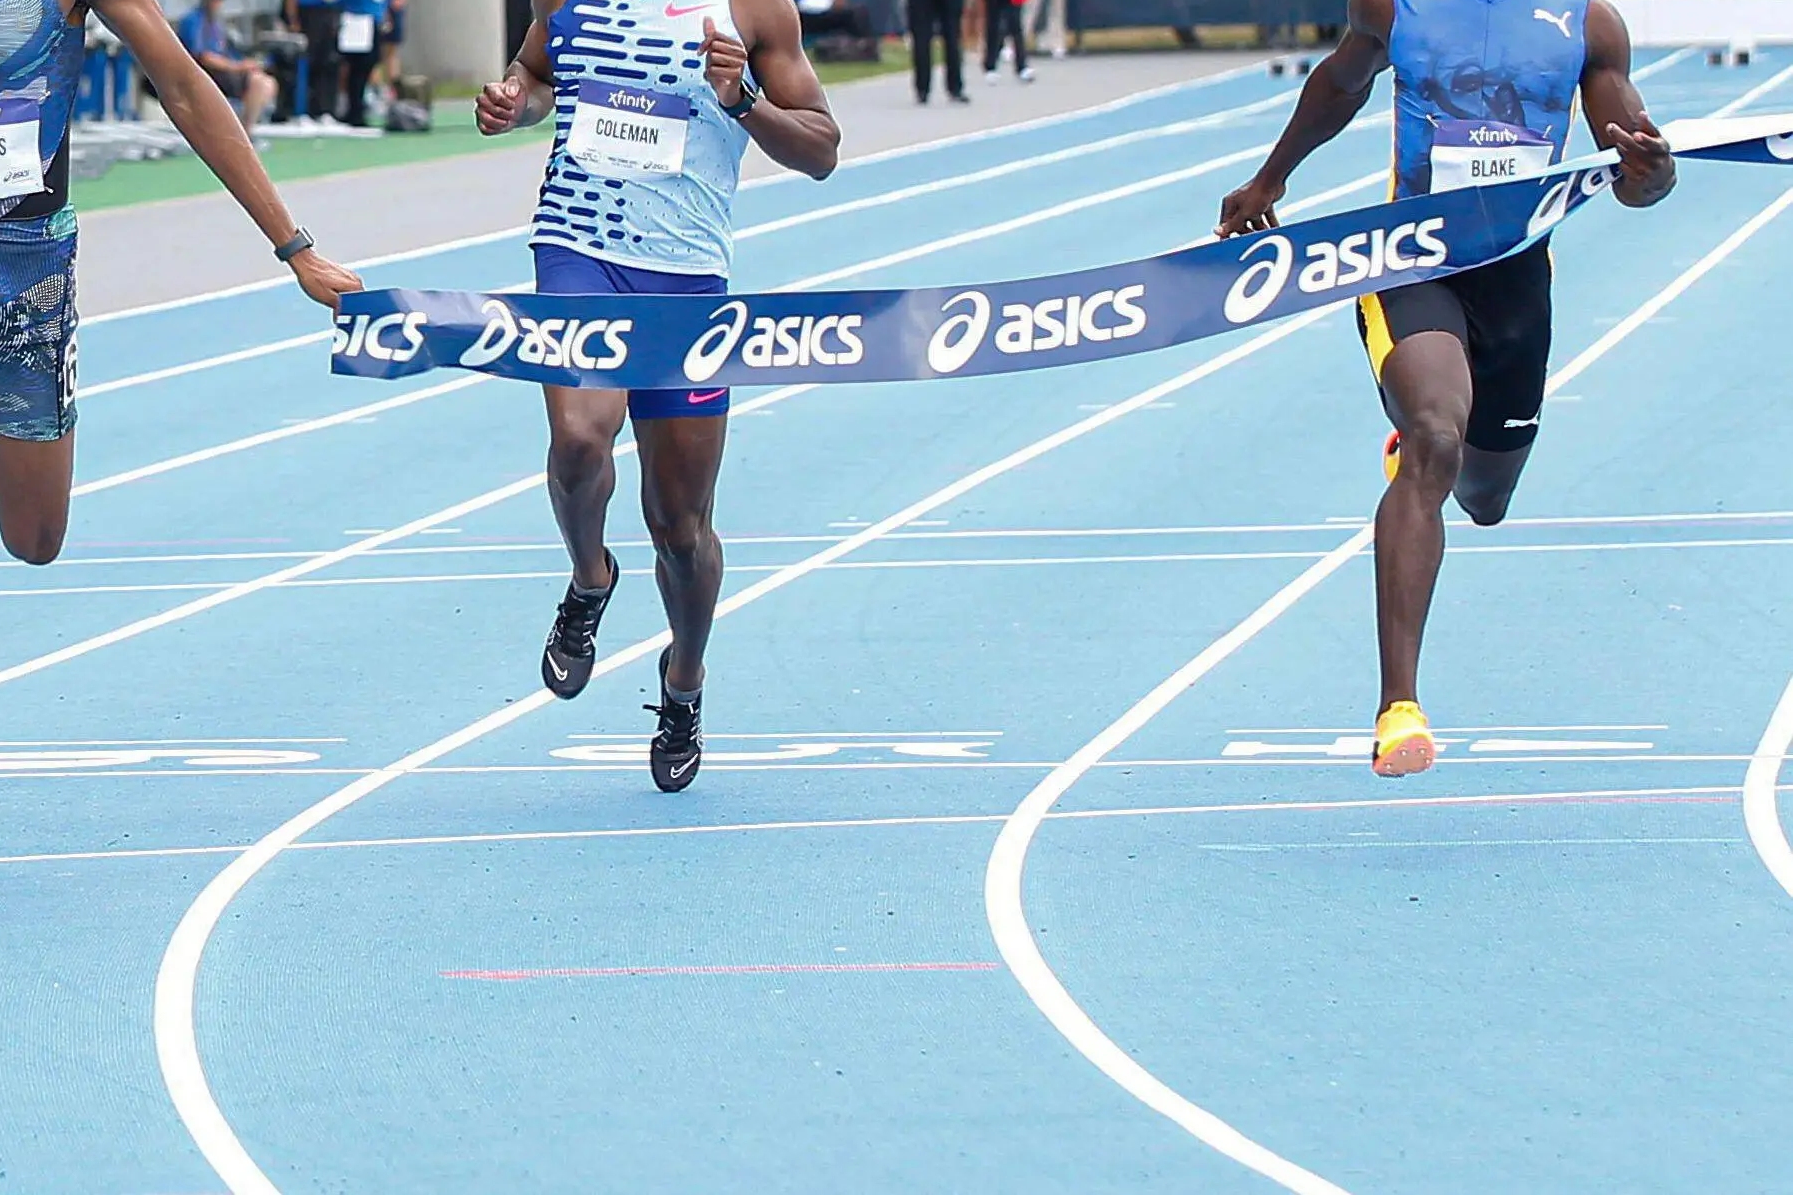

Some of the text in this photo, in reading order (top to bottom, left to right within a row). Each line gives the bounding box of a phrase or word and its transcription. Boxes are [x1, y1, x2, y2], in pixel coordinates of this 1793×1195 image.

[608, 90, 656, 113] xfinity
[596, 118, 659, 145] COLEMAN
[1469, 126, 1519, 145] xfinity
[1471, 158, 1516, 177] BLAKE
[1298, 217, 1448, 293] asics
[332, 312, 427, 361] sics
[742, 315, 863, 367] asics
[995, 284, 1147, 354] asics
[517, 318, 633, 370] asics
